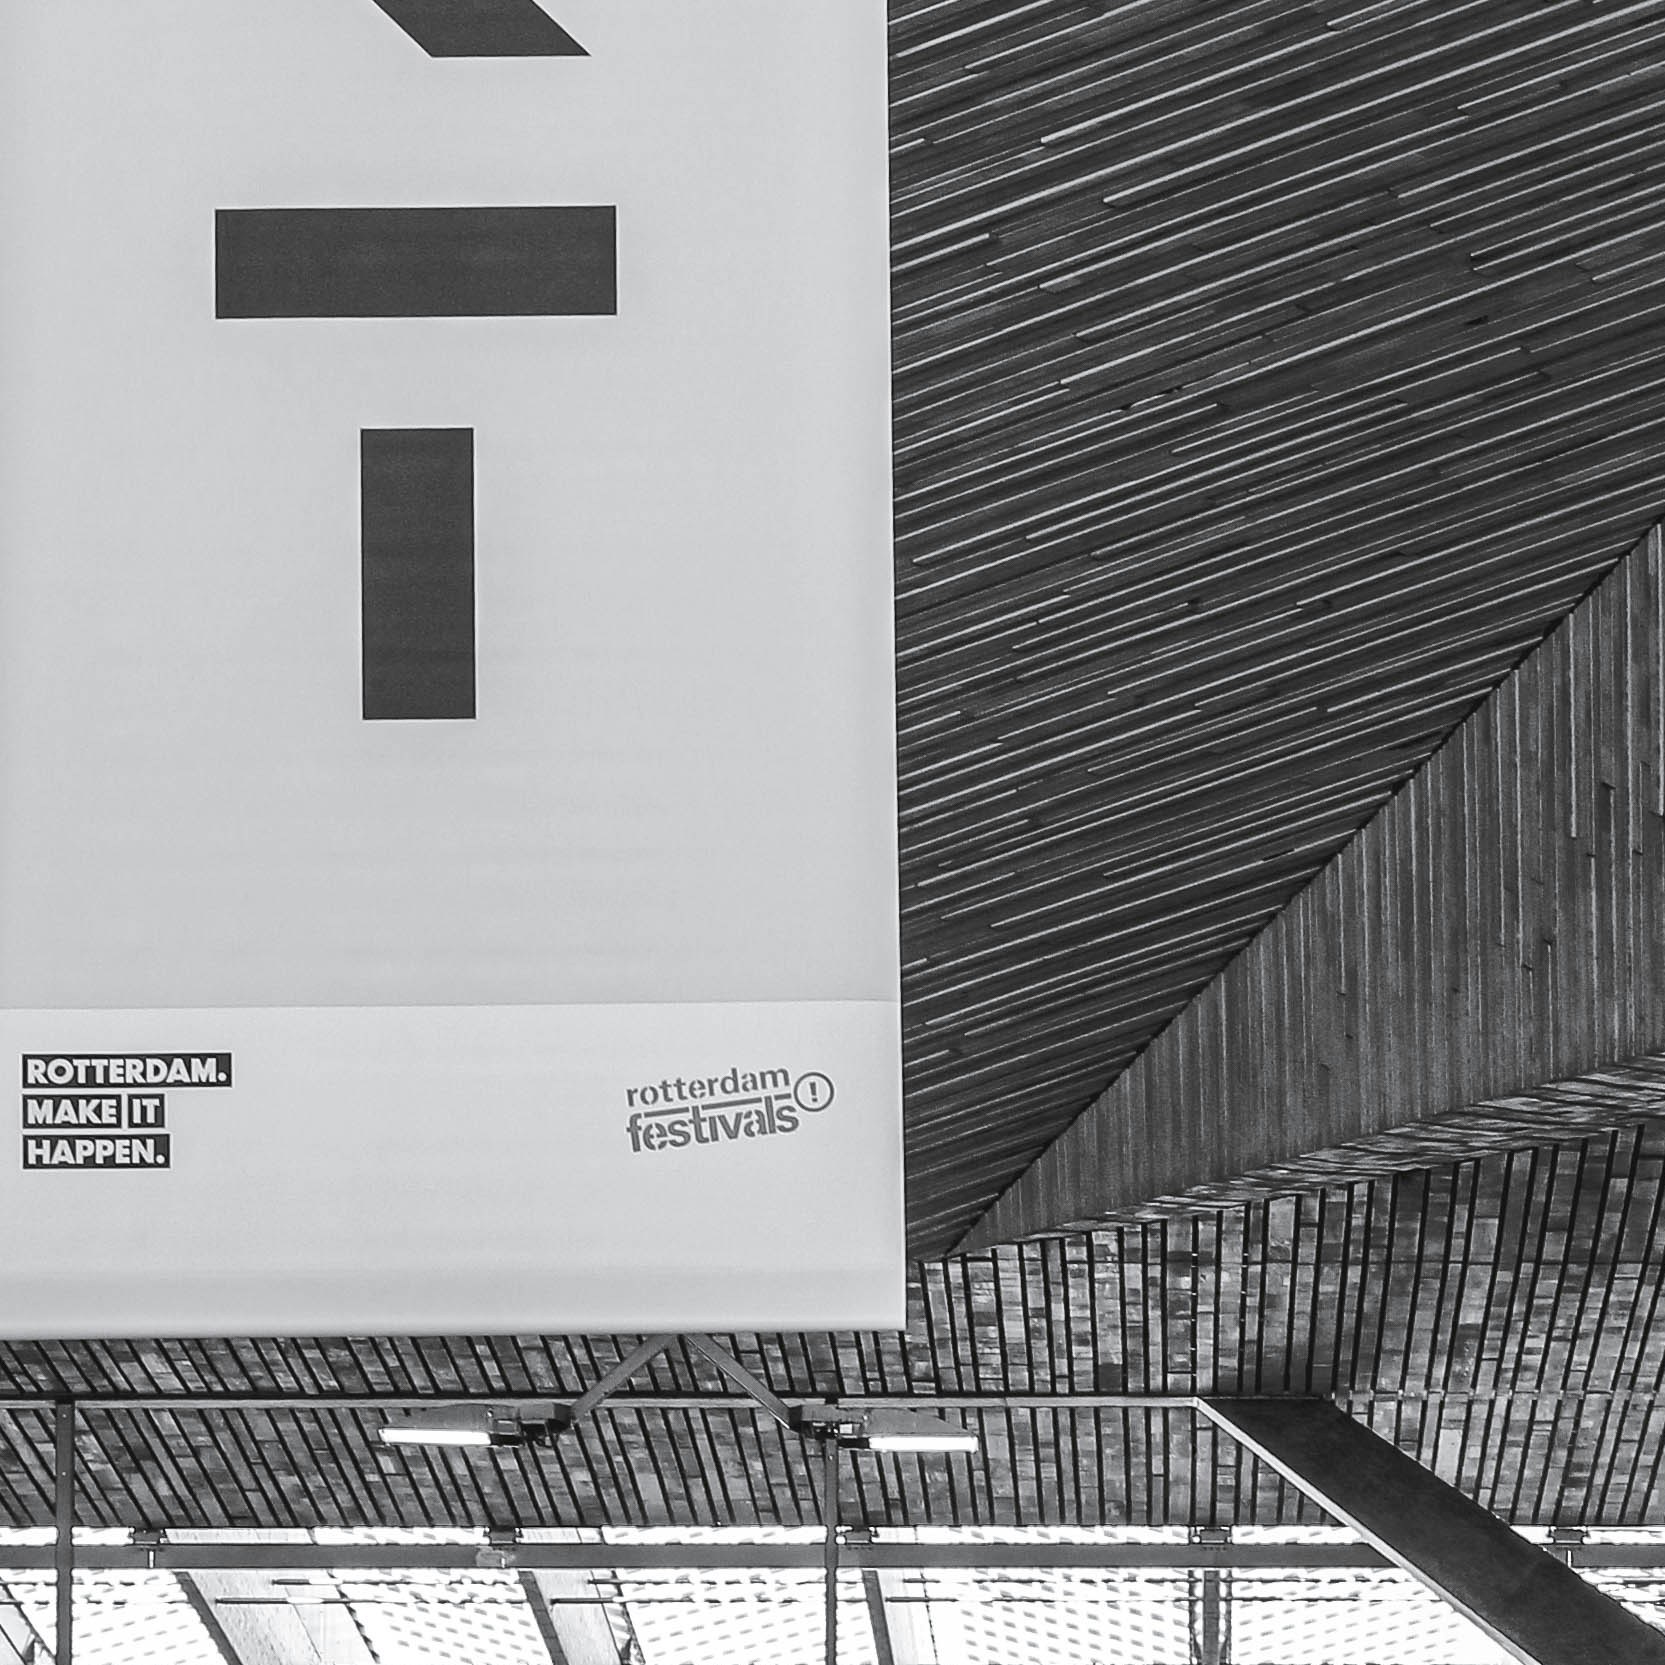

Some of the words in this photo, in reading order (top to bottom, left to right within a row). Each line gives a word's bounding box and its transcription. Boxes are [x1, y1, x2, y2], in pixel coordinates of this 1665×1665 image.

[27, 1057, 227, 1085] ROTTERDAM.
[626, 1067, 790, 1107] rotterdam
[27, 1098, 117, 1124] MAKE
[132, 1098, 160, 1124] IT
[626, 1095, 799, 1153] festivals
[27, 1138, 165, 1165] HAPPEN.
